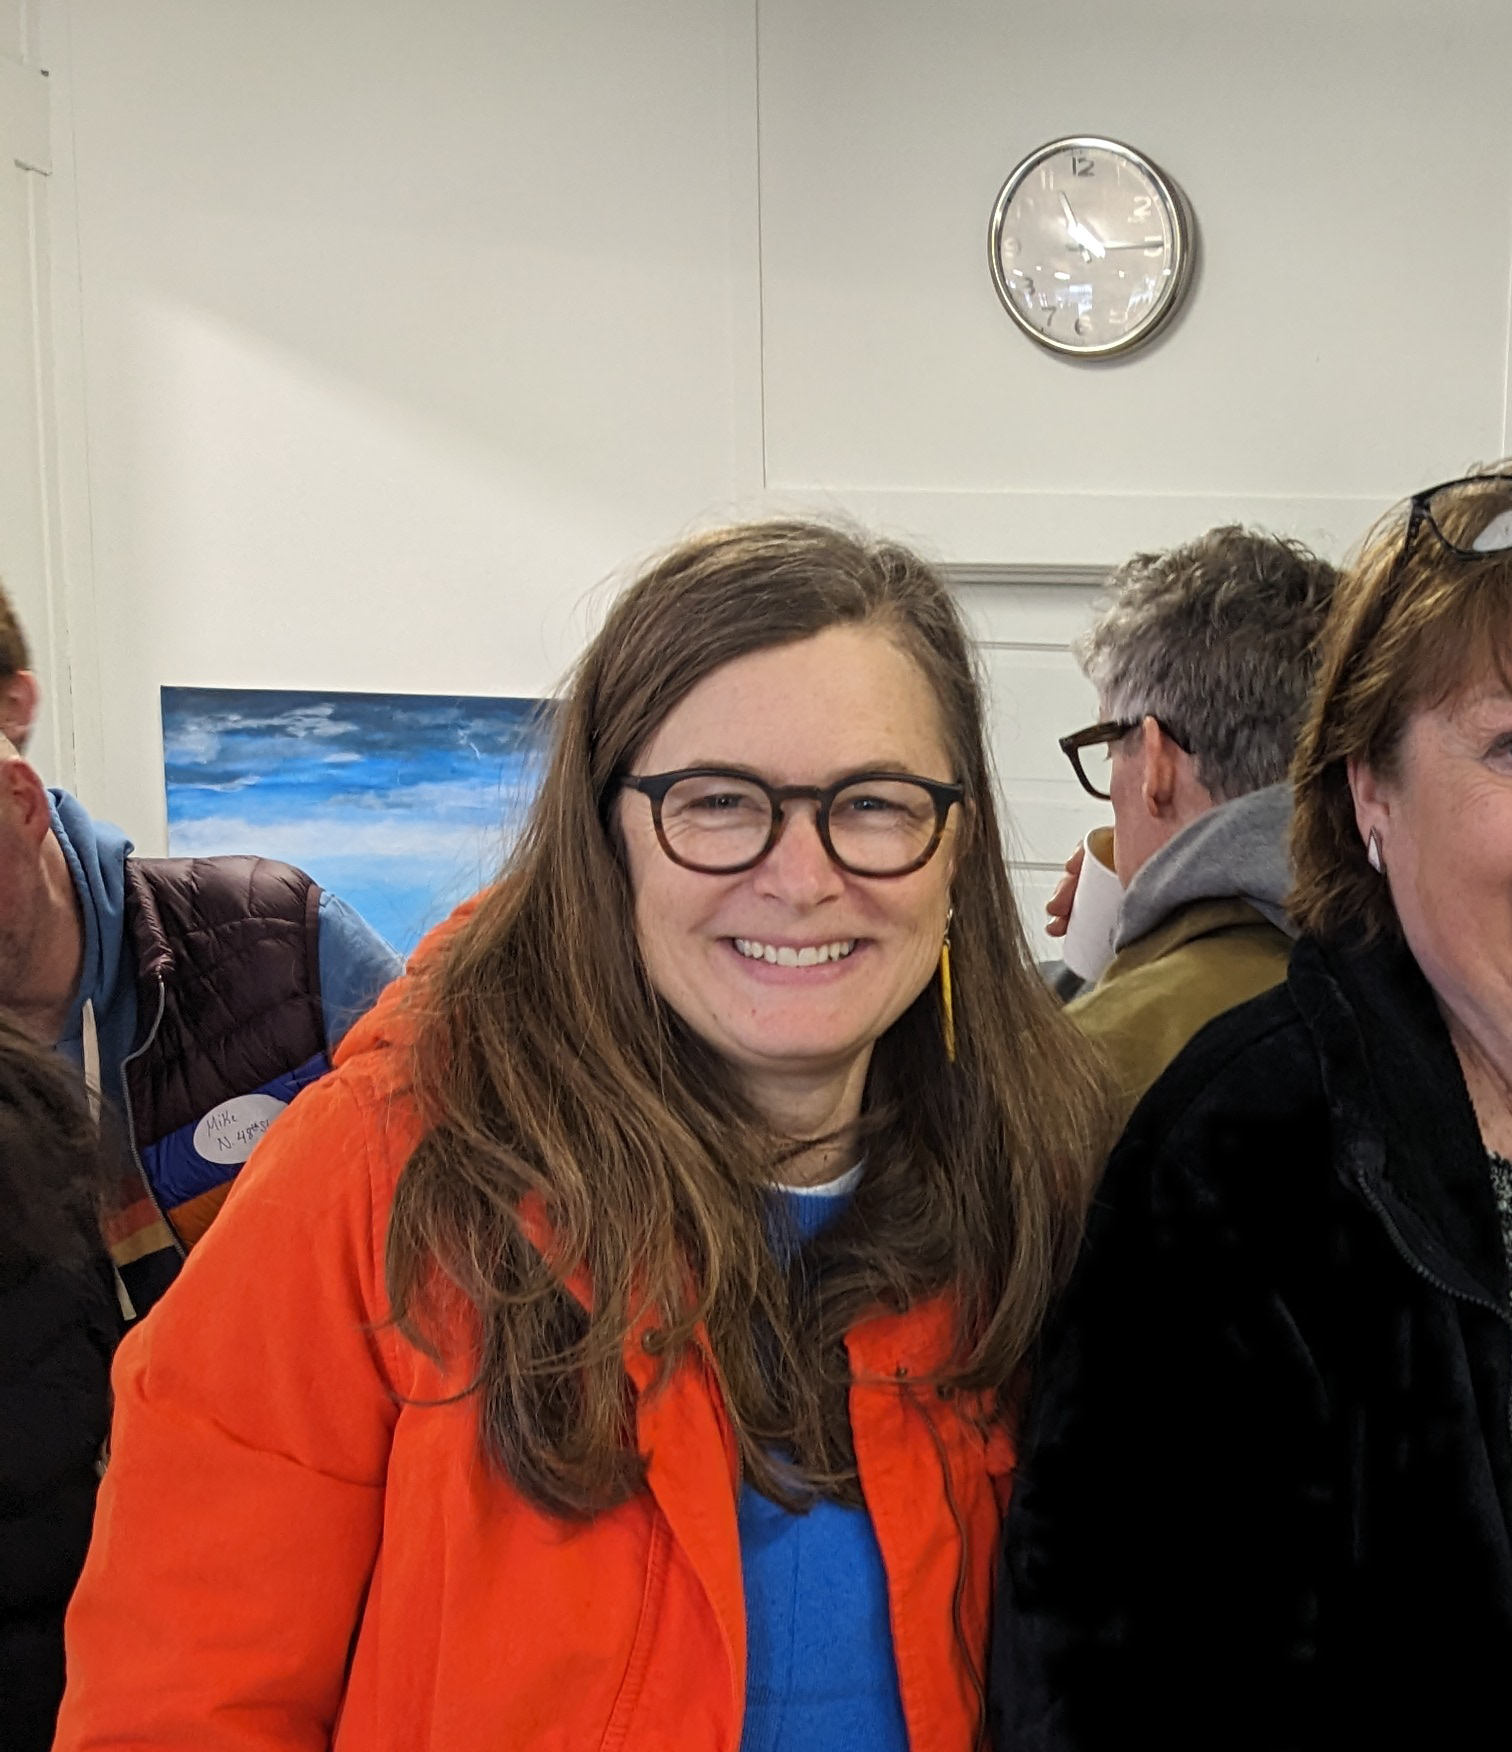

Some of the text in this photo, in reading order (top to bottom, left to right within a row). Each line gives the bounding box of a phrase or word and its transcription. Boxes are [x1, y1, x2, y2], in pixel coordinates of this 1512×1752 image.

[1072, 156, 1095, 177] 12
[1133, 195, 1152, 218] 2
[1041, 305, 1057, 327] 7
